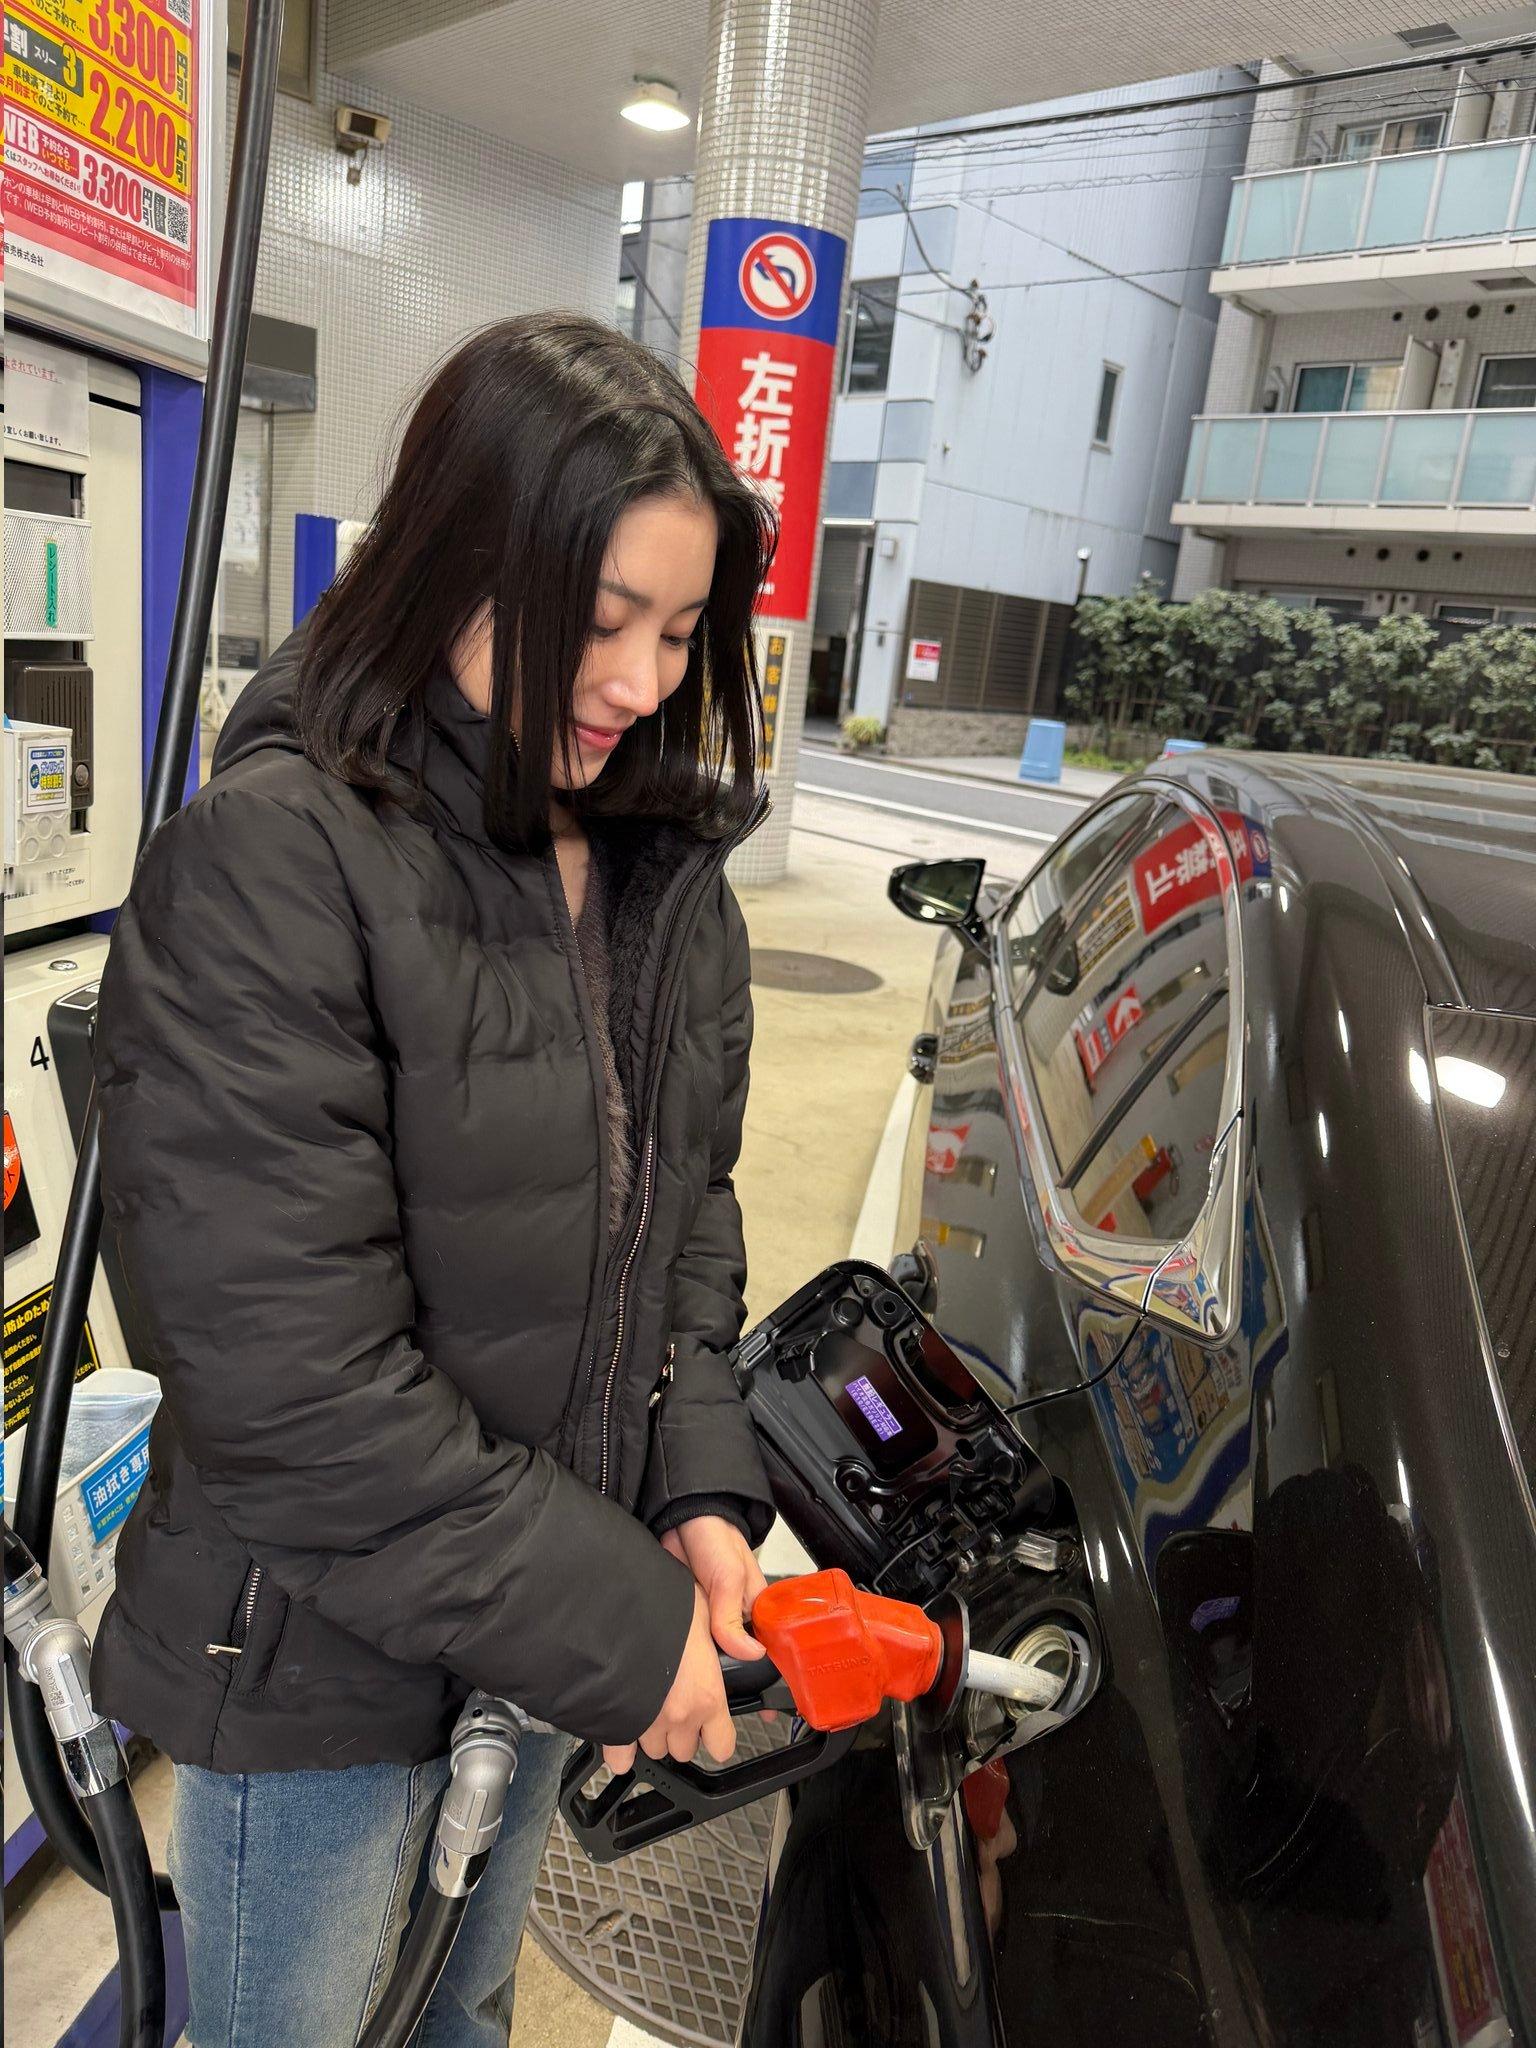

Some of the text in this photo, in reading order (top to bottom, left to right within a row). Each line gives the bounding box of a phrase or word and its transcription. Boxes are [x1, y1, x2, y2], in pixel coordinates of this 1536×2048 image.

[33, 45, 57, 65] スリー
[62, 43, 77, 88] 3
[88, 0, 176, 95] 3,300
[89, 69, 176, 179] 2,200
[82, 153, 142, 223] 3,300
[30, 1036, 50, 1071] 4
